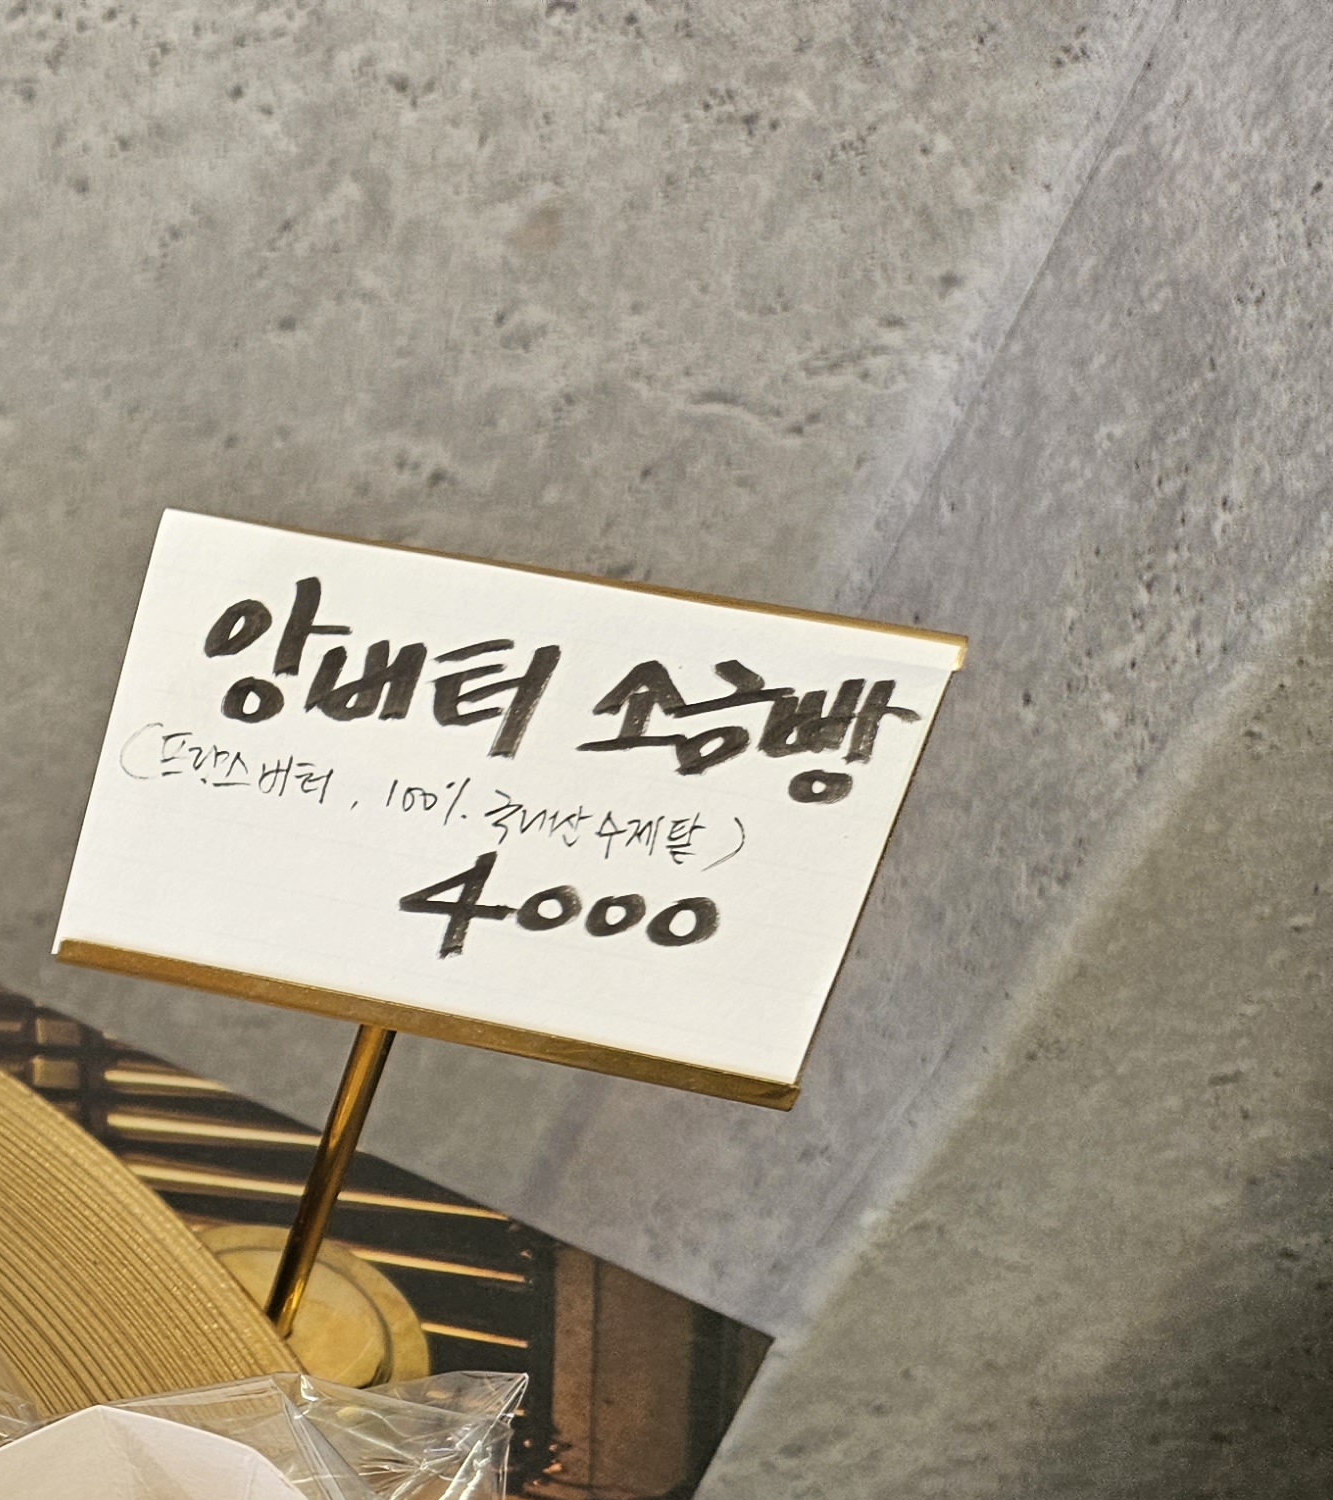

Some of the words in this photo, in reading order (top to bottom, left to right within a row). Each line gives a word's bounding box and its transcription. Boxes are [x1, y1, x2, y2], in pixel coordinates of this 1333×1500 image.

[204, 575, 562, 758] 앙버터
[575, 657, 921, 804] 소금빵
[398, 850, 721, 959] 4000
